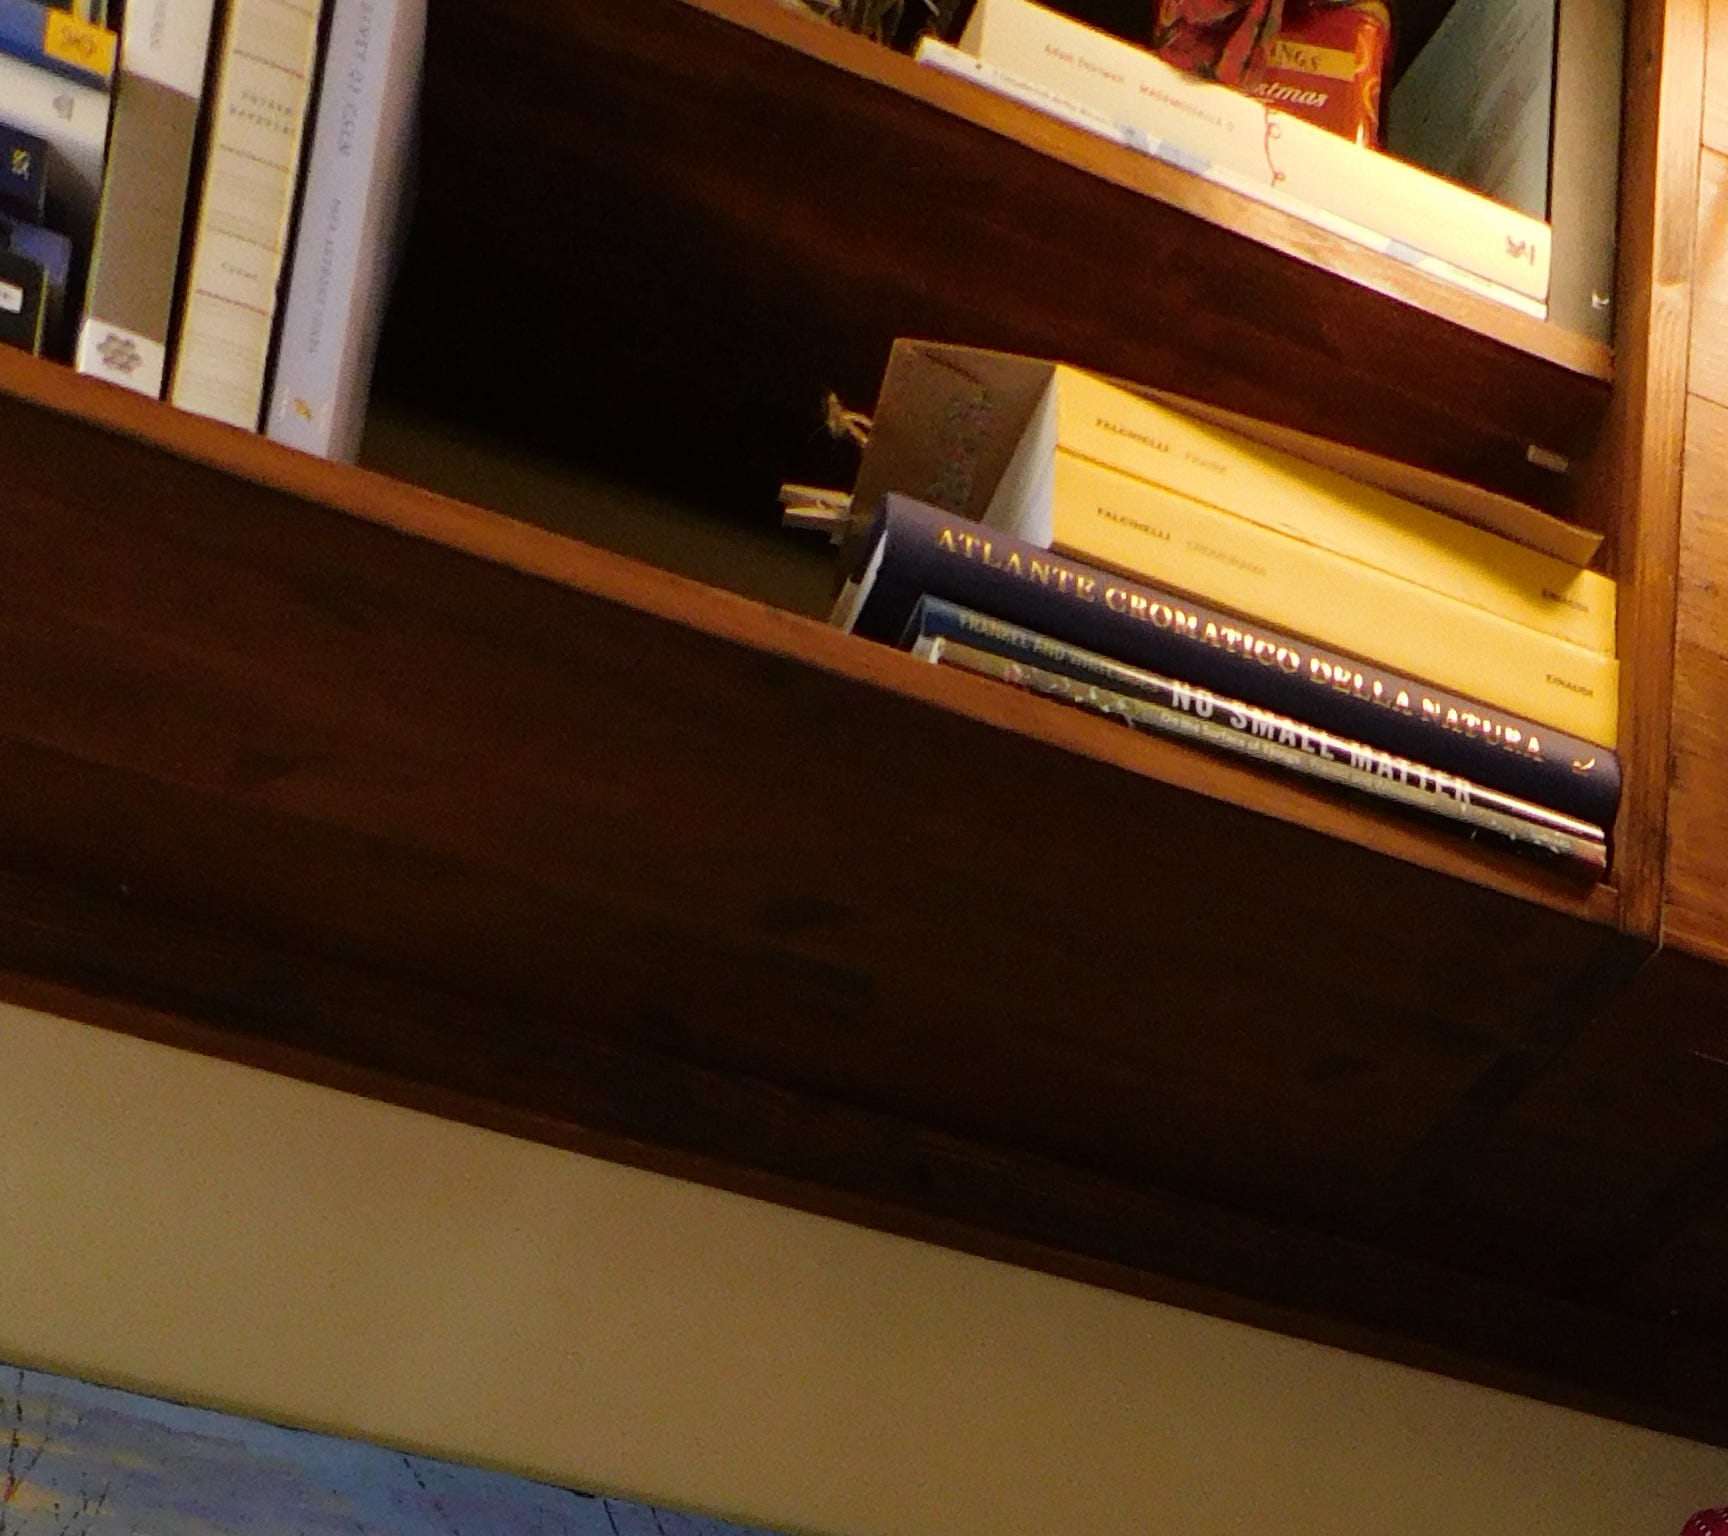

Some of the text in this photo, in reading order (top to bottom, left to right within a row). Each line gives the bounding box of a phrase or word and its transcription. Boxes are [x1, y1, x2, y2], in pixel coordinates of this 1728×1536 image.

[1257, 82, 1330, 107] stmas
[938, 527, 1097, 603] ATLANTE
[1104, 586, 1302, 674] CROMATICO
[1308, 656, 1413, 717] DELLA
[1171, 680, 1474, 812] NO SMALL MATTER
